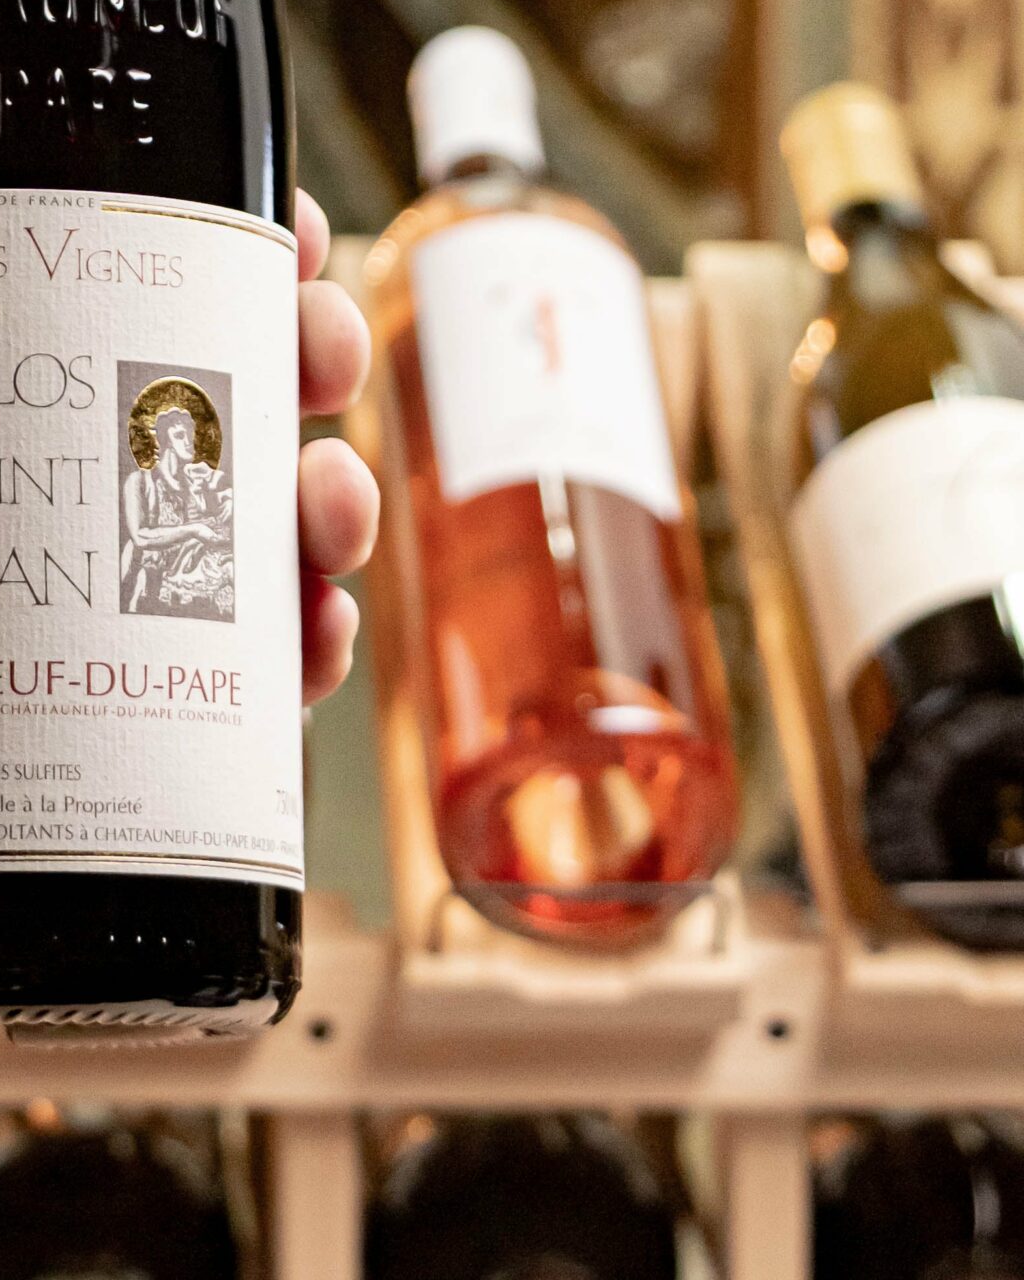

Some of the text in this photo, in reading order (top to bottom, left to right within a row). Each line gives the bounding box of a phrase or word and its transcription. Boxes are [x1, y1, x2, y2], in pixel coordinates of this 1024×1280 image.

[28, 195, 96, 210] FRANCE
[24, 226, 184, 288] VIGNES
[14, 763, 82, 782] SULFITES
[23, 795, 33, 812] à
[41, 794, 56, 813] la
[64, 796, 143, 818] Propriété
[79, 824, 89, 841] à
[94, 824, 249, 850] CHATEAUNEUF-DU-PAPE
